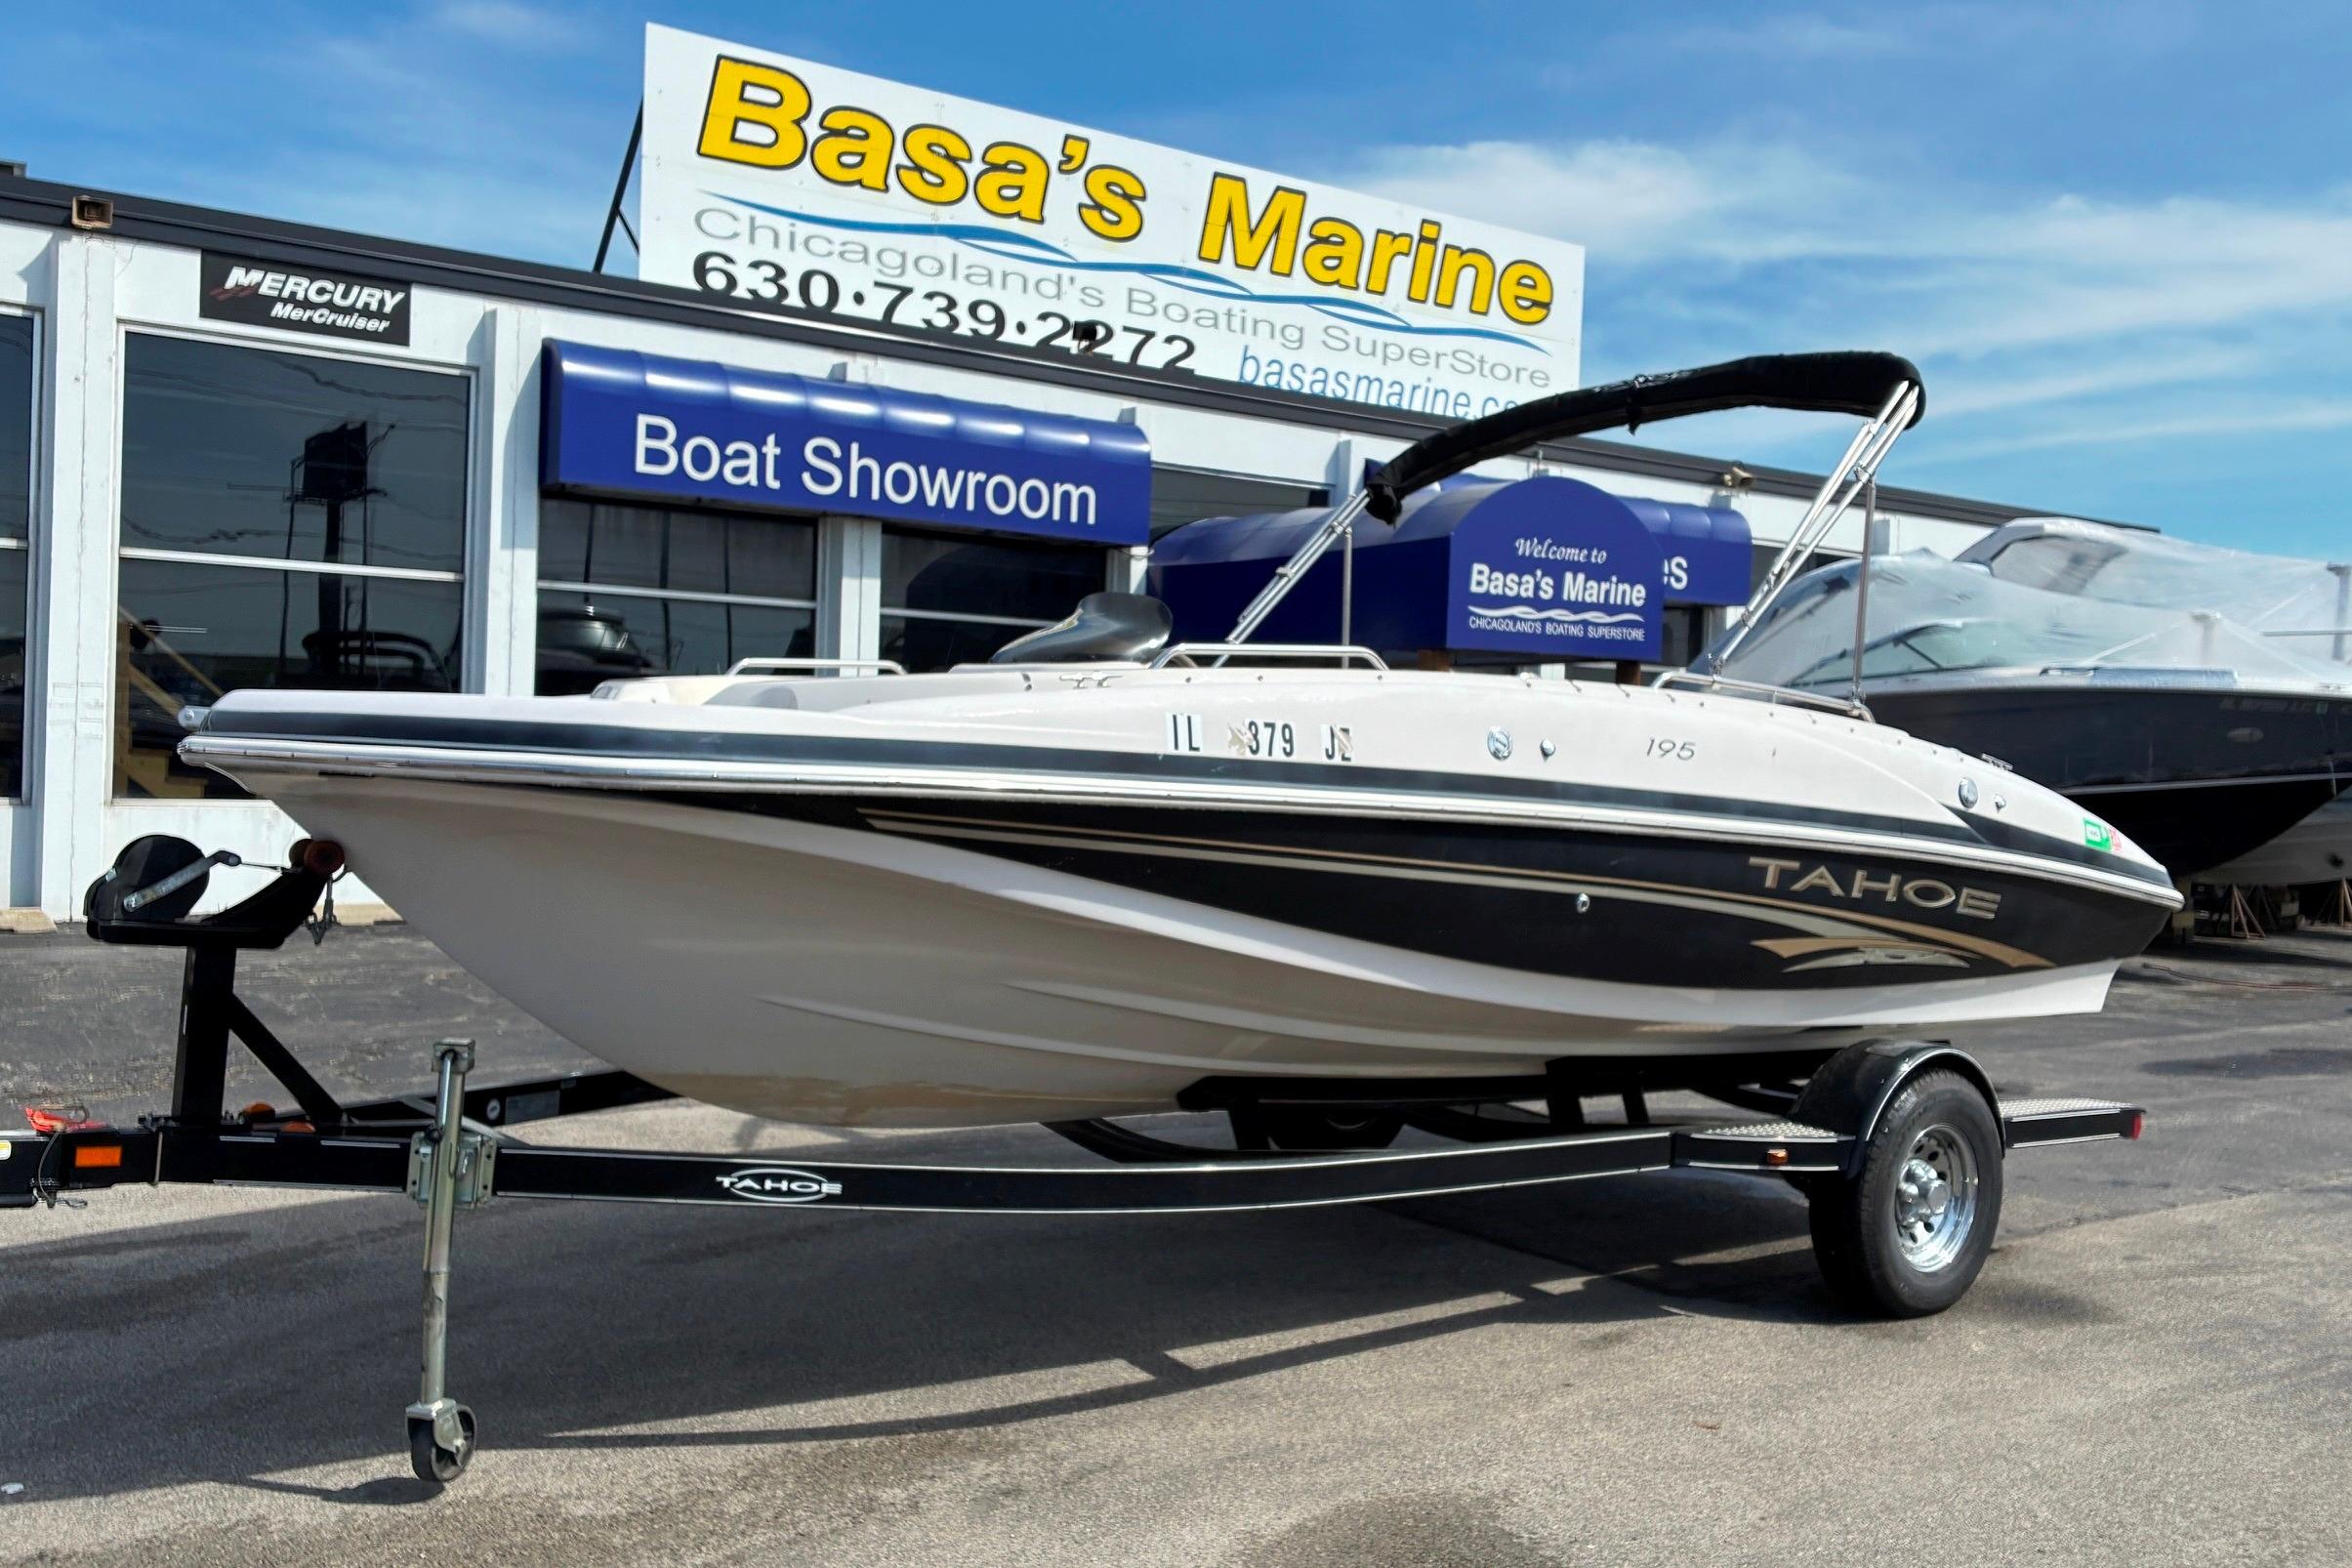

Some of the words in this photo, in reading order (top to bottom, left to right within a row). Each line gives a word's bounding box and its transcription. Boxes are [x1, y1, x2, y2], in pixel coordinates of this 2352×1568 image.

[696, 55, 1146, 242] Basa's
[1198, 171, 1554, 326] Marine
[224, 266, 406, 314] MERCURY
[693, 207, 1105, 309] Chicagoland's
[1126, 287, 1304, 351] Boating
[1321, 324, 1550, 389] SuperStore
[270, 302, 391, 333] MerCruiser
[634, 413, 781, 490] Boat
[801, 435, 1097, 526] Showroom
[1515, 536, 1589, 563] Welcome
[1589, 547, 1607, 564] to
[1469, 561, 1554, 600] Basa's
[1563, 570, 1646, 607] Marine
[1468, 616, 1542, 635] CHICAGOLAND'S
[1546, 621, 1585, 639] BOATING
[1588, 625, 1646, 642] SUPERSTORE
[1172, 714, 1201, 753] IL
[1646, 737, 1696, 761] 195
[1748, 855, 2001, 920] TAHOE
[716, 1176, 843, 1195] TAHOE
